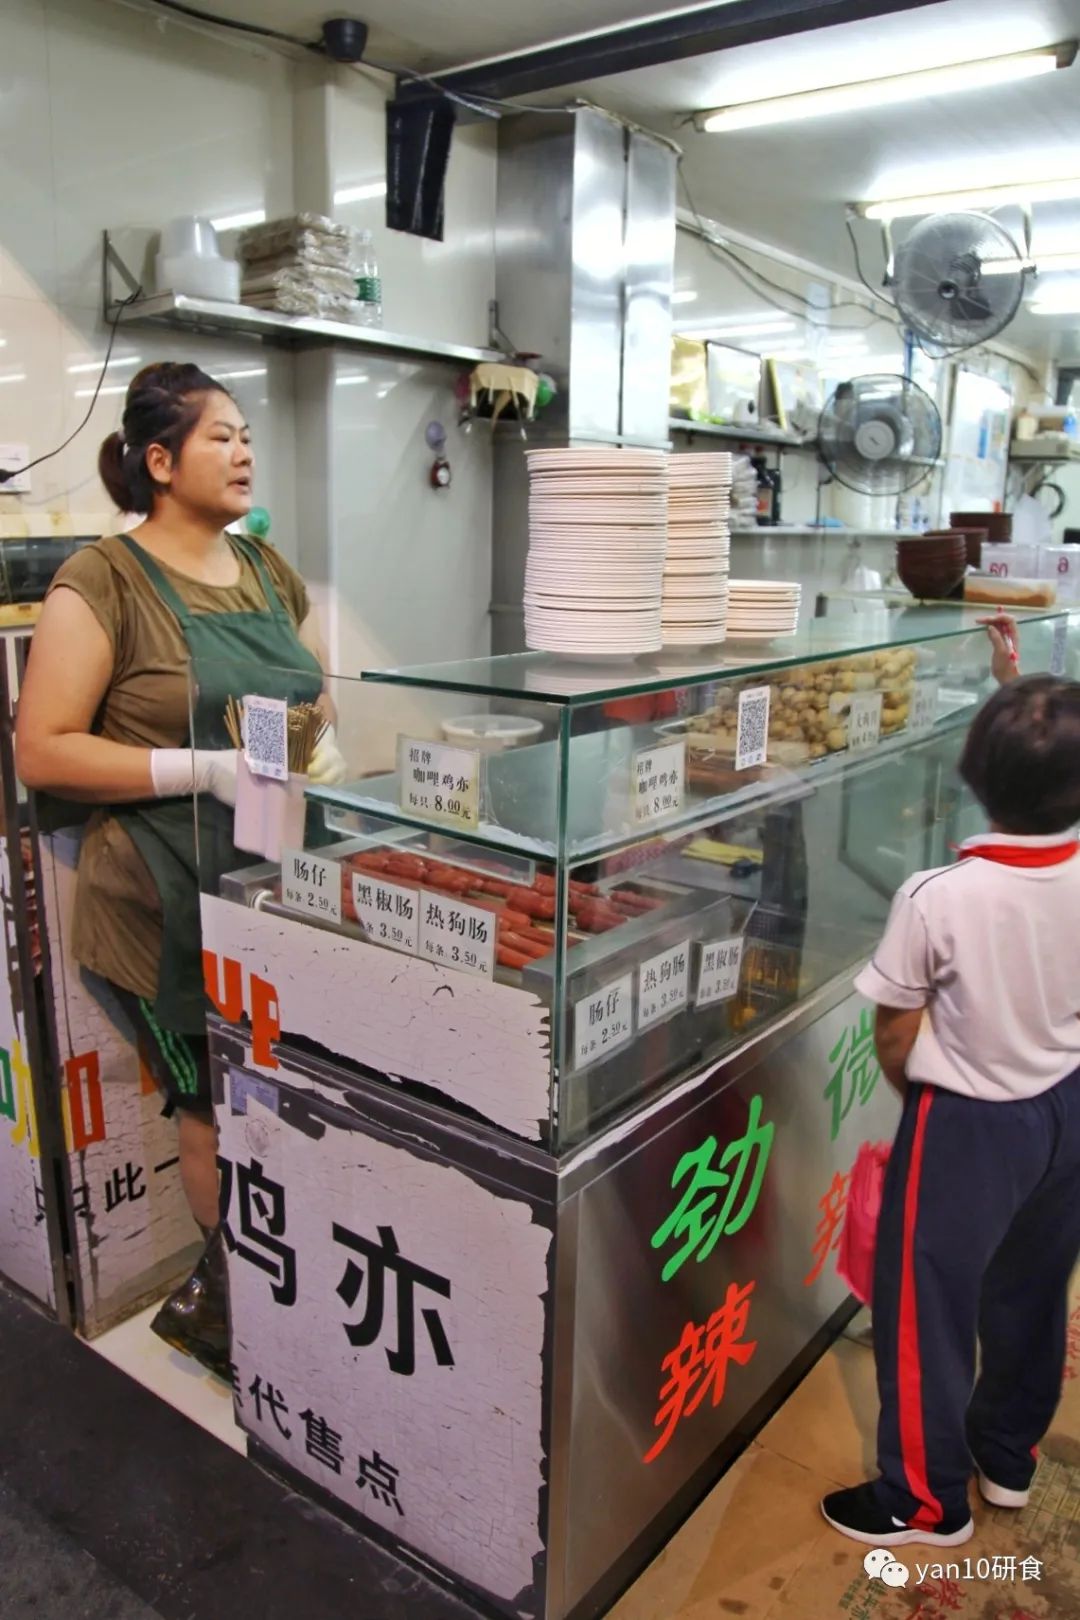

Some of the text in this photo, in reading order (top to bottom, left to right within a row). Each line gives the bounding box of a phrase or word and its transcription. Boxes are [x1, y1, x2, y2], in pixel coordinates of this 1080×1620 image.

[409, 747, 432, 765] 招牌
[294, 857, 328, 887] 肠仔
[357, 882, 414, 920] 黑椒肠
[426, 902, 488, 943] 热狗肠
